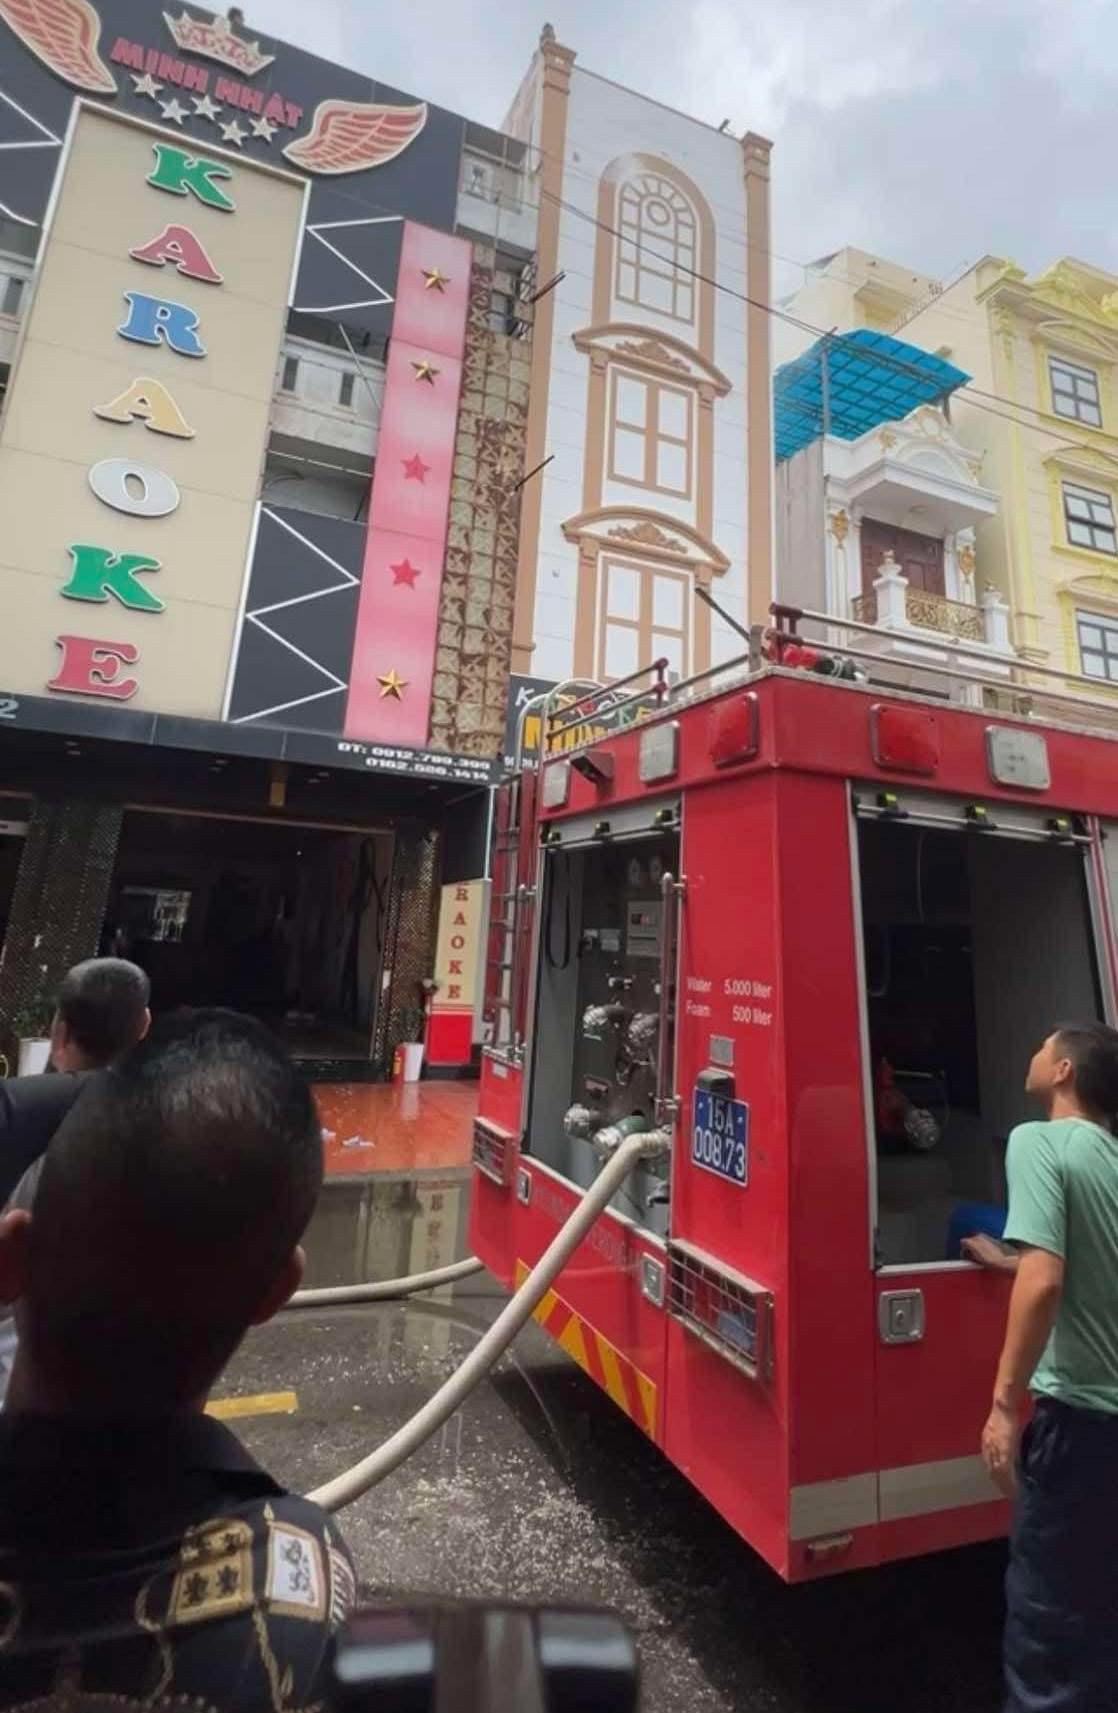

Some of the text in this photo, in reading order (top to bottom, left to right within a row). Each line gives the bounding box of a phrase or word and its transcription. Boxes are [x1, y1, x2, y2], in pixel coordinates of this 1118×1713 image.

[110, 37, 209, 94] MINH
[48, 142, 236, 699] KARAOKE
[447, 881, 469, 999] RAOKE
[732, 1005, 752, 1022] 500
[707, 1096, 735, 1136] 15A
[694, 1126, 746, 1178] 008.73
